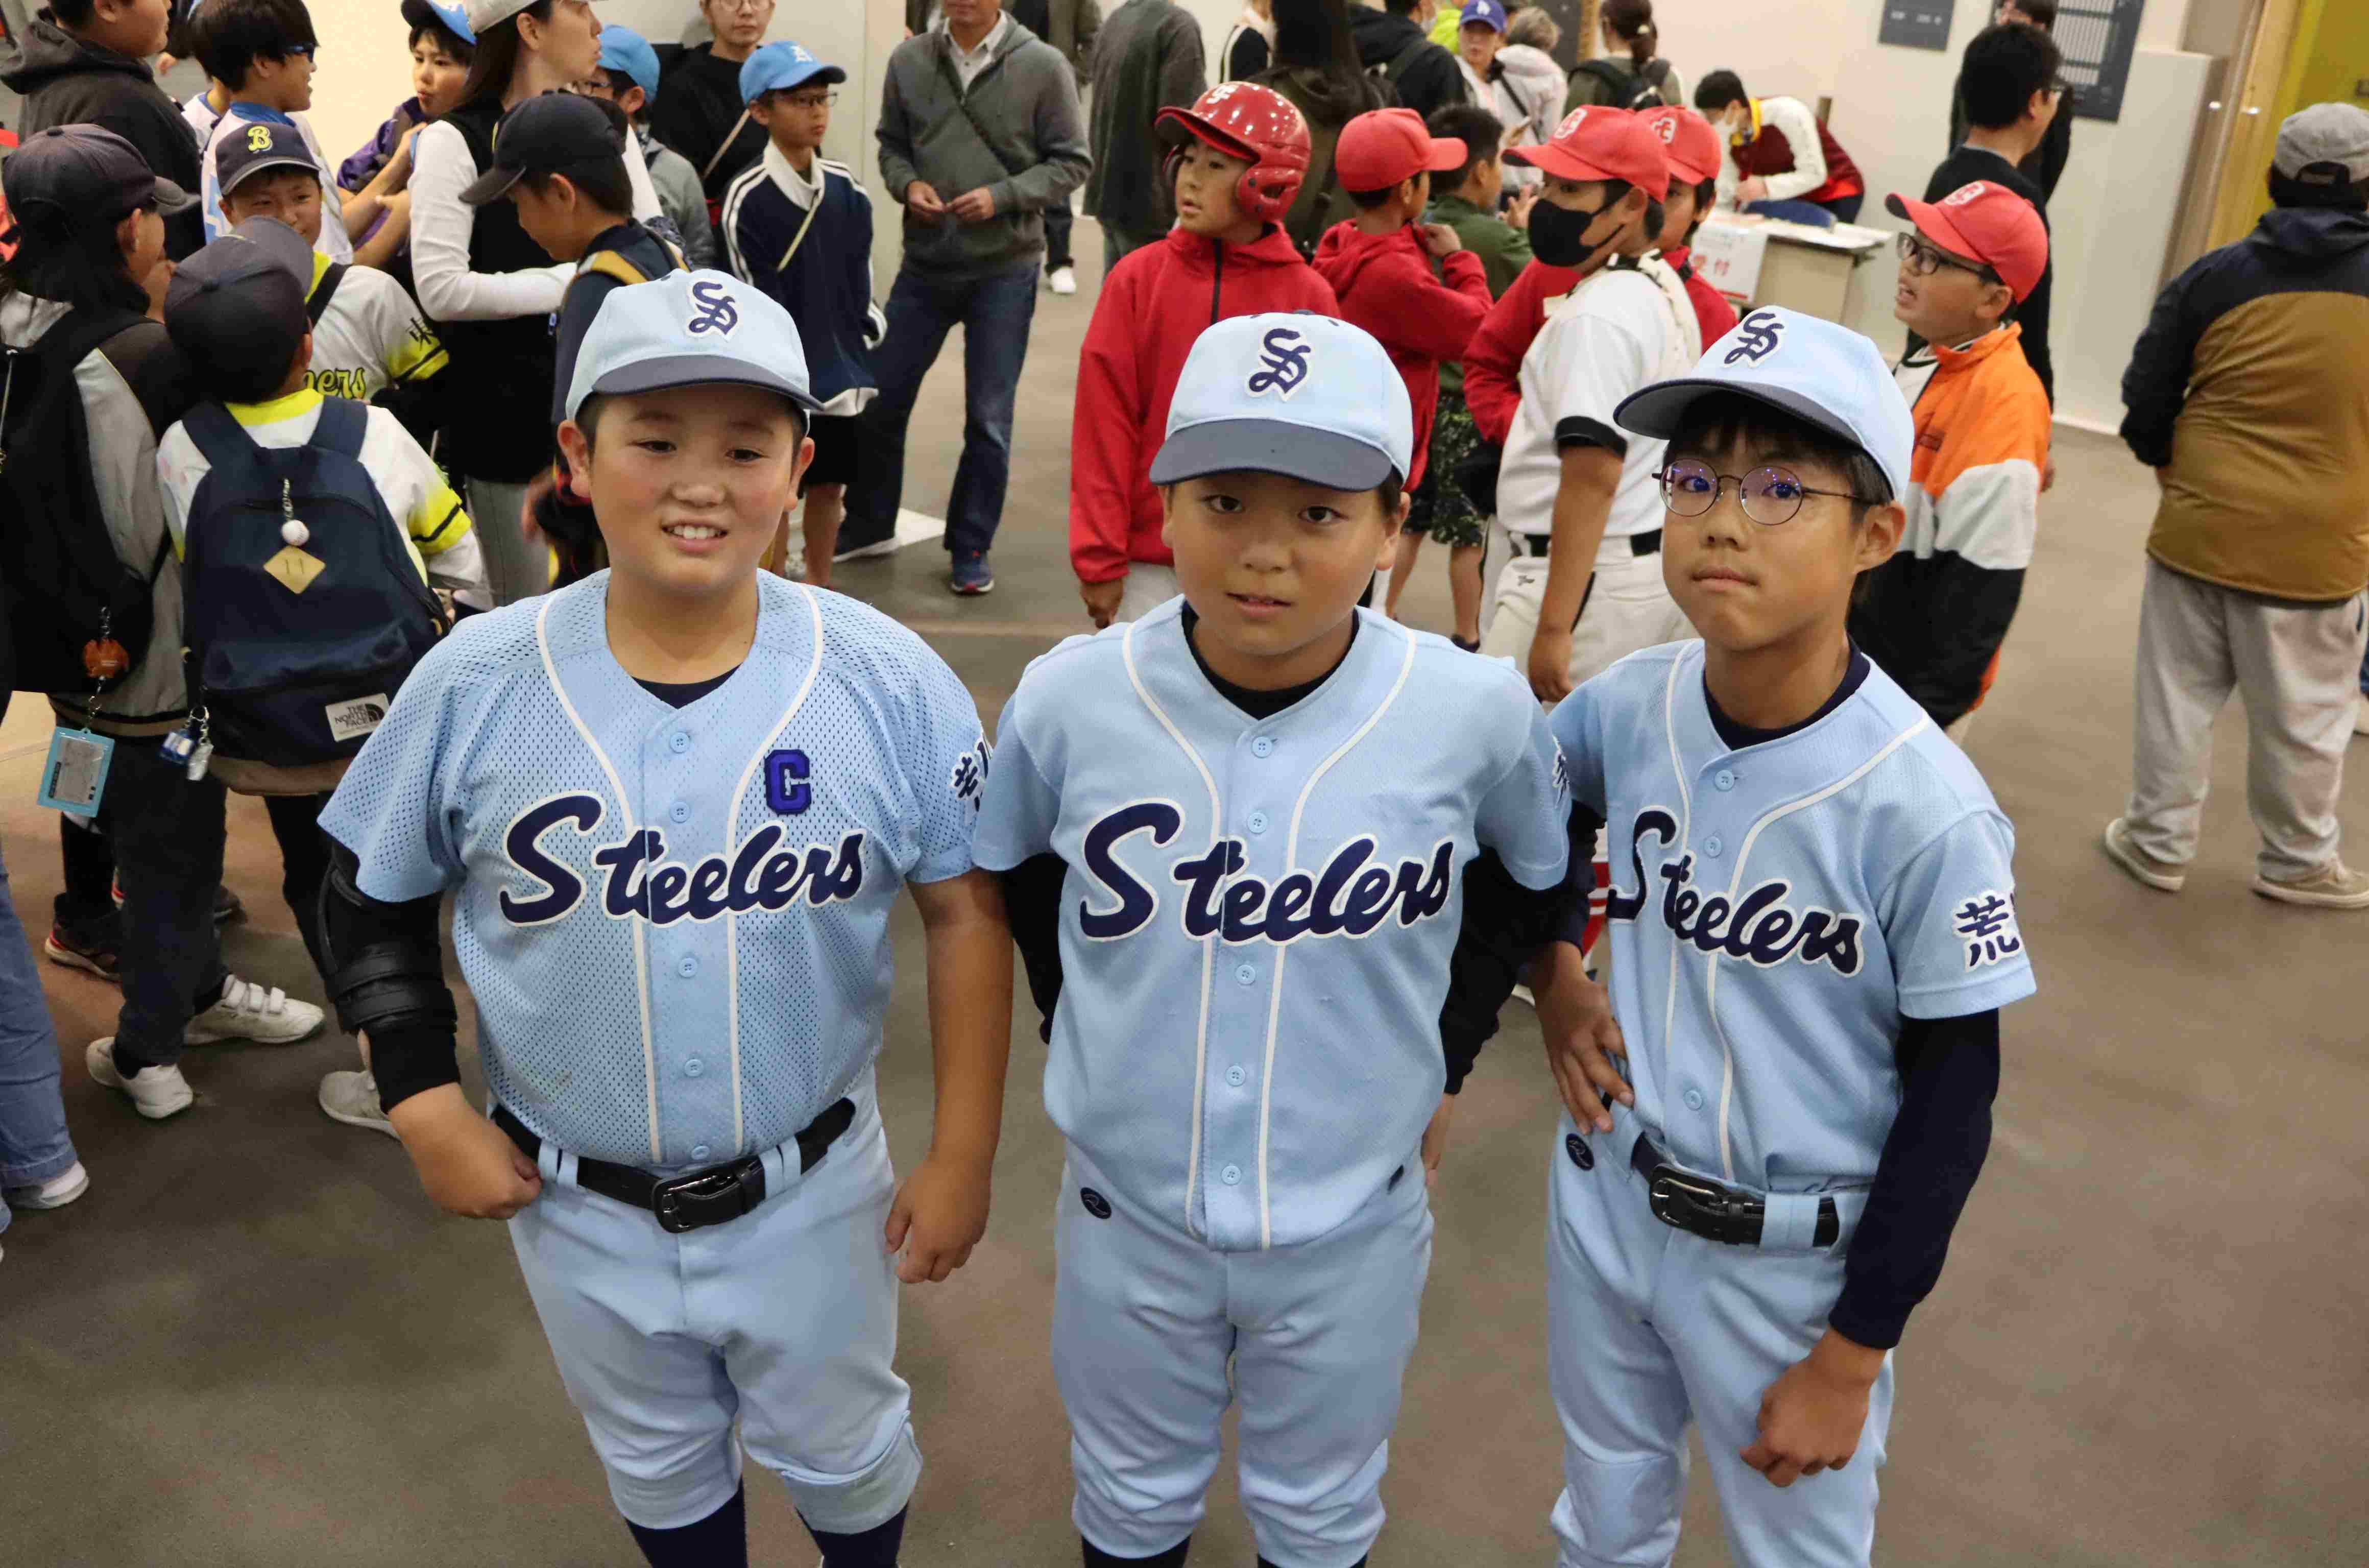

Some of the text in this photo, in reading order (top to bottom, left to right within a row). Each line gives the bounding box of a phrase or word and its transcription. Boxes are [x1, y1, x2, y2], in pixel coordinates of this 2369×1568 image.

[248, 126, 273, 153] B
[764, 749, 811, 814] C
[500, 793, 864, 926] Steelers
[1079, 801, 1454, 944] Steelers
[1606, 809, 1861, 975] Steelers
[1956, 894, 2020, 967] 荒
